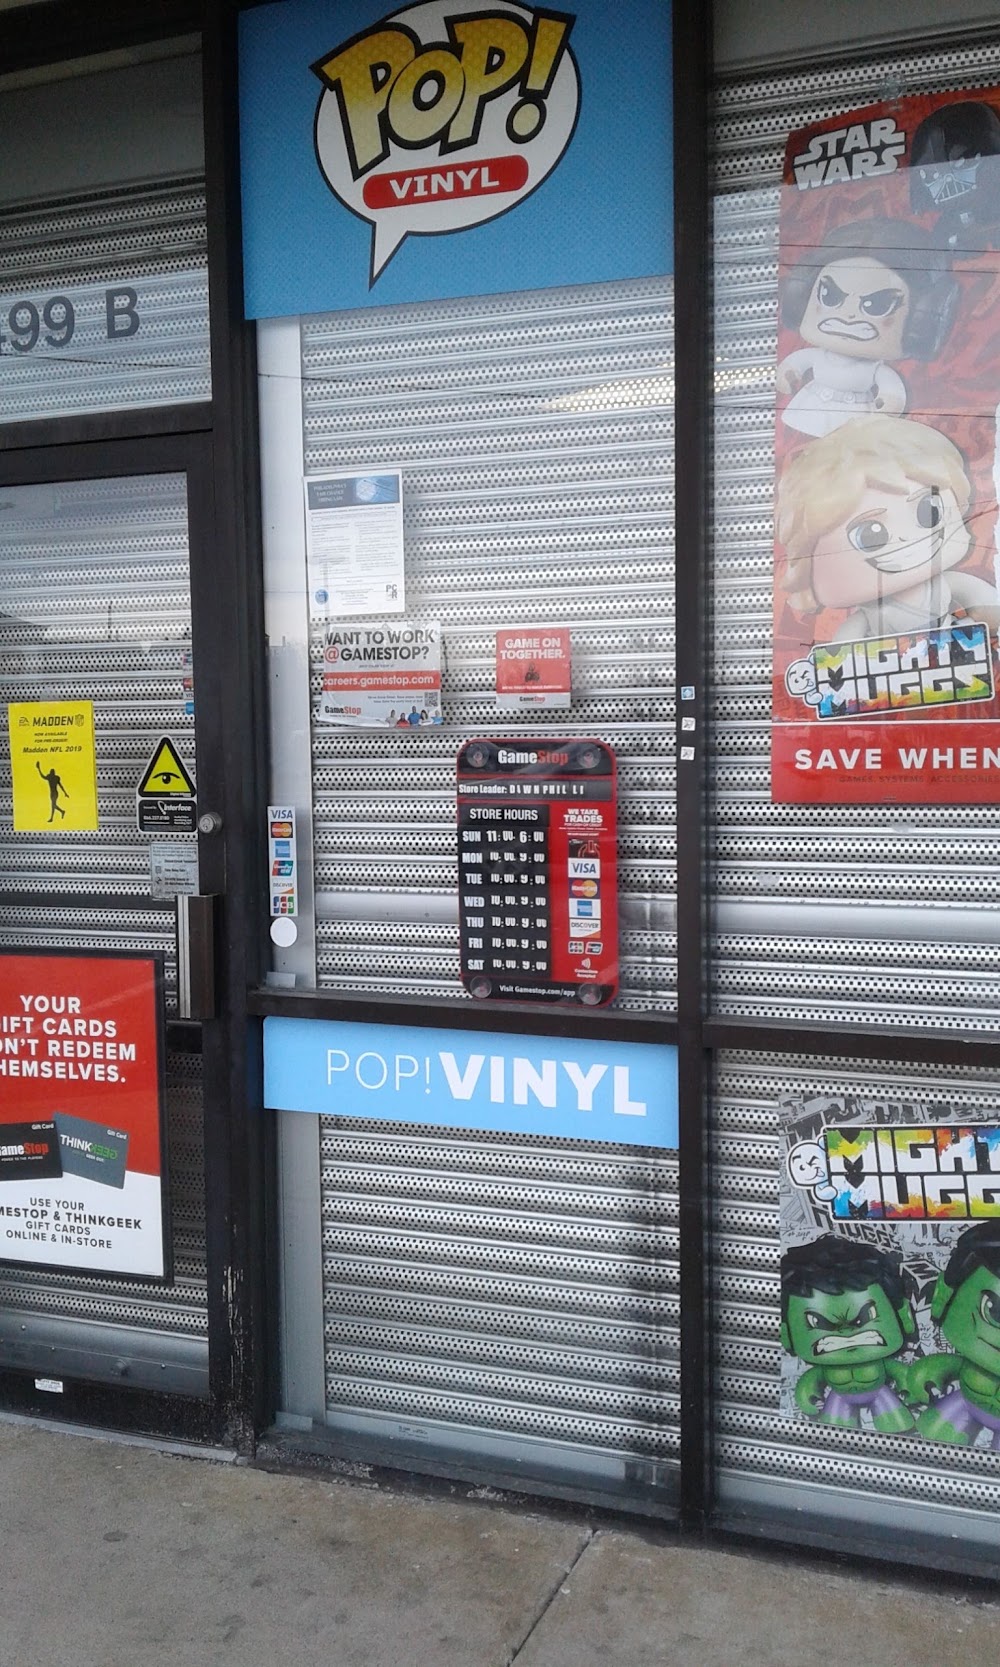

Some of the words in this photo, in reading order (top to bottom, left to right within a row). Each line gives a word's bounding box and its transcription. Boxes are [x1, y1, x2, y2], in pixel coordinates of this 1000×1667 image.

[310, 0, 577, 178] POP!
[794, 118, 905, 164] STAR
[794, 145, 905, 190] WARS
[389, 167, 500, 202] VINYL
[0, 295, 75, 353] 99
[105, 286, 140, 339] B
[365, 631, 384, 644] TO
[387, 629, 435, 643] WORK
[505, 638, 540, 649] GAME
[542, 637, 561, 648] ON
[500, 648, 566, 660] TOGETHER.
[815, 627, 987, 680] MIGHTY
[817, 662, 990, 716] MUGGS
[325, 706, 361, 716] GameStop
[33, 715, 74, 727] MADDEN
[498, 749, 569, 766] GameStop
[795, 748, 882, 770] SAVE
[898, 747, 1000, 770] WHEN
[459, 784, 479, 794] Store
[480, 785, 508, 795] Leader:
[271, 809, 293, 819] VISA
[470, 808, 502, 820] STORE
[503, 809, 539, 821] HOURS
[563, 814, 603, 824] TRADES
[462, 830, 481, 842] SUN
[461, 852, 483, 864] MON
[572, 862, 597, 874] VISA
[464, 873, 483, 885] TUE
[463, 896, 485, 908] WED
[465, 916, 485, 928] THU
[571, 921, 600, 929] DISCOVER
[468, 937, 483, 949] FRI
[467, 959, 485, 971] SAT
[499, 985, 514, 993] Visit
[515, 986, 576, 997] Gamestop.com/app
[20, 995, 81, 1014] YOUR
[0, 1015, 35, 1034] IFT
[42, 1018, 117, 1038] CARDS
[0, 1037, 39, 1056] N'T
[47, 1039, 136, 1061] REDEEM
[326, 1049, 431, 1095] POP!
[438, 1051, 647, 1117] VINYL
[116, 1131, 127, 1140] Card
[30, 1197, 51, 1207] USE
[55, 1199, 85, 1211] YOUR
[53, 1211, 61, 1221] &
[65, 1212, 142, 1229] THINKGEEK
[25, 1220, 51, 1231] GIFT
[54, 1223, 91, 1235] CARDS
[6, 1229, 47, 1242] ONLINE
[50, 1233, 57, 1243] &
[61, 1234, 113, 1249] IN-STORE
